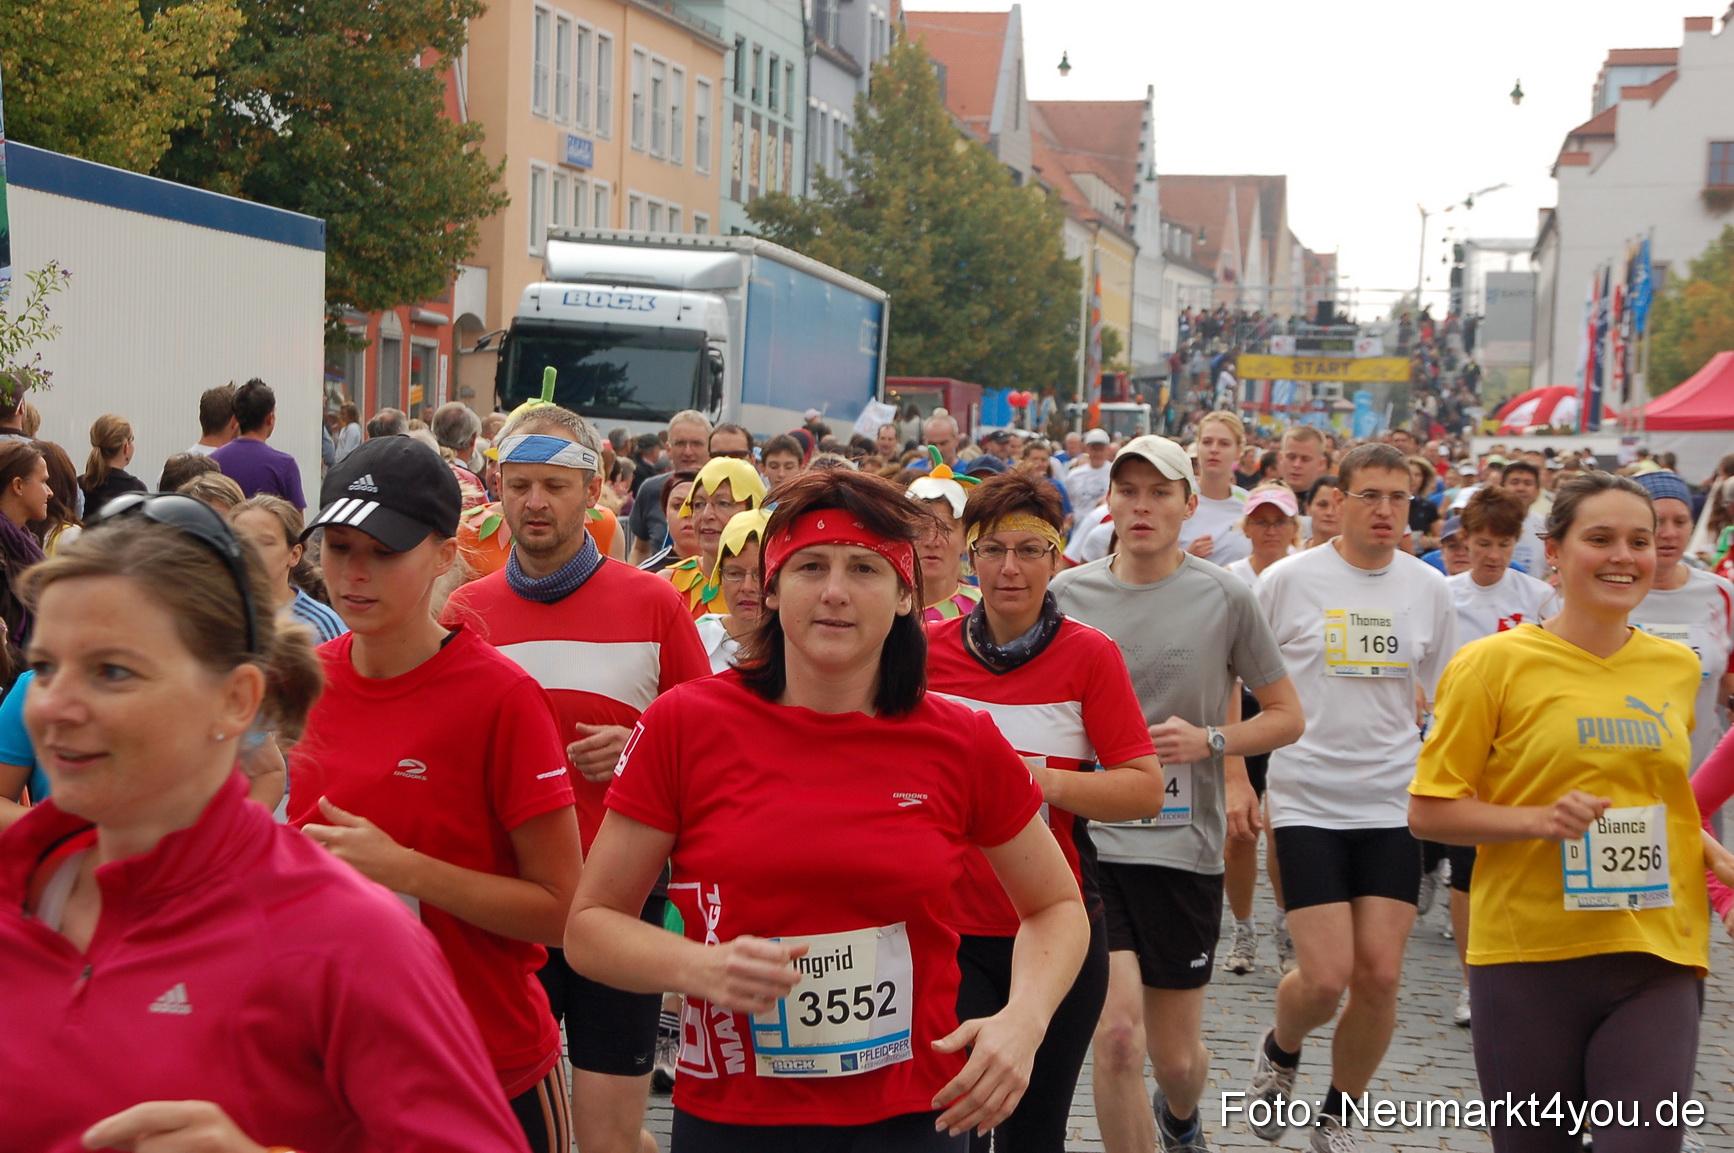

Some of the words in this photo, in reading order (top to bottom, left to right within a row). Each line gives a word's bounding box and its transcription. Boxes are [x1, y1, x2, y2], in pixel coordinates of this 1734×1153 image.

[563, 290, 657, 312] BOCK
[1292, 361, 1351, 375] START
[348, 484, 378, 493] adidas
[1350, 613, 1392, 627] Thomas
[1360, 635, 1399, 654] 169
[1577, 717, 1662, 747] PUMA
[393, 771, 428, 781] BROOKS
[892, 792, 928, 800] BROOKS
[1597, 816, 1645, 834] Bianca
[1571, 845, 1578, 859] D
[1601, 845, 1662, 872] 3256
[798, 981, 898, 1027] 3552
[859, 1039, 910, 1063] PFLEIDERER
